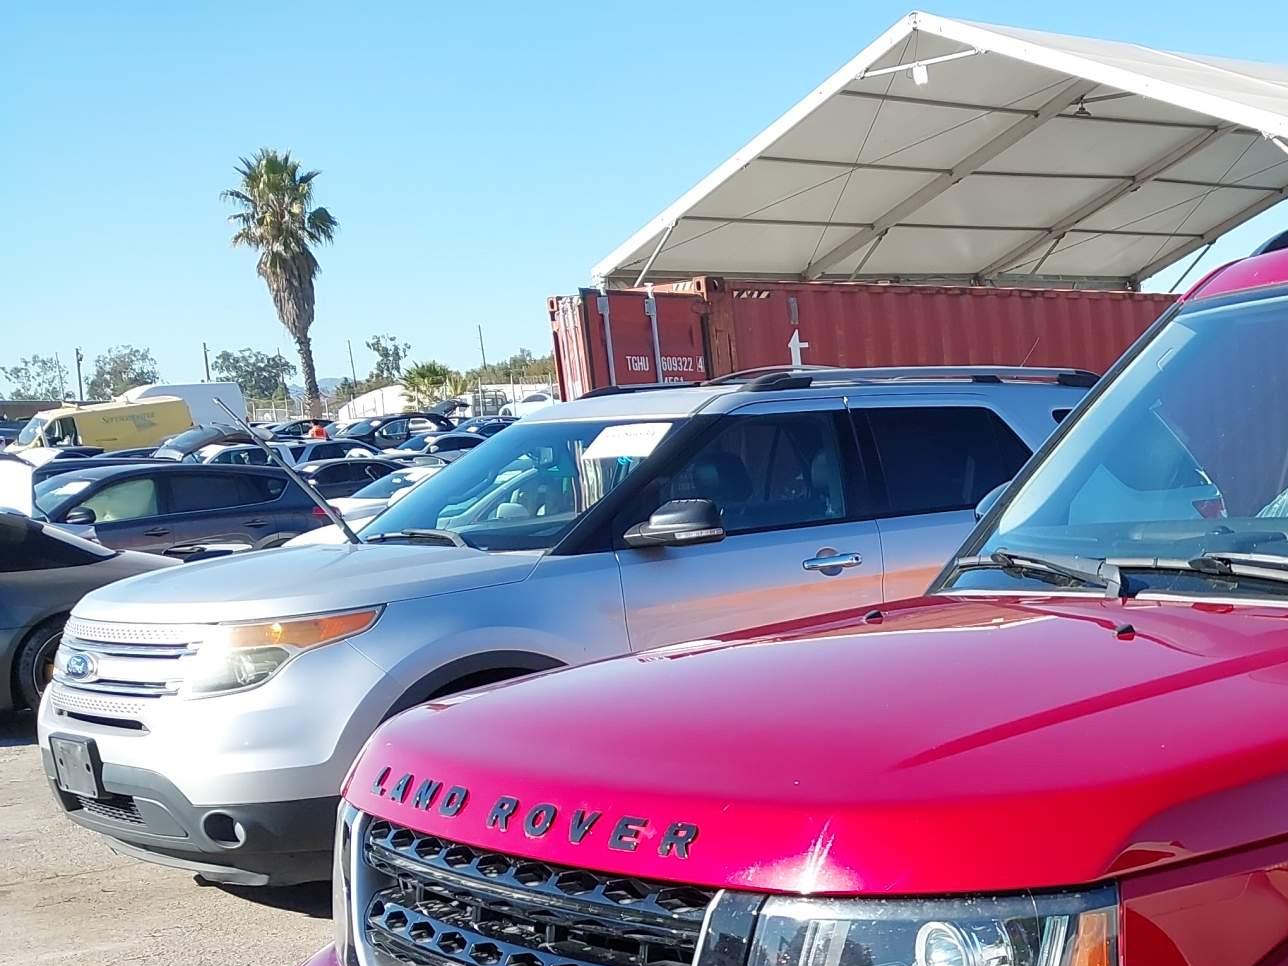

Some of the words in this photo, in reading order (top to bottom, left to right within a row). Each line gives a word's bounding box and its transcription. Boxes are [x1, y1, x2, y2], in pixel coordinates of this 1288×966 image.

[625, 355, 650, 372] TGHU
[661, 355, 694, 372] 609322
[697, 356, 705, 371] 4
[370, 766, 470, 818] LAND
[485, 795, 699, 860] ROVER
